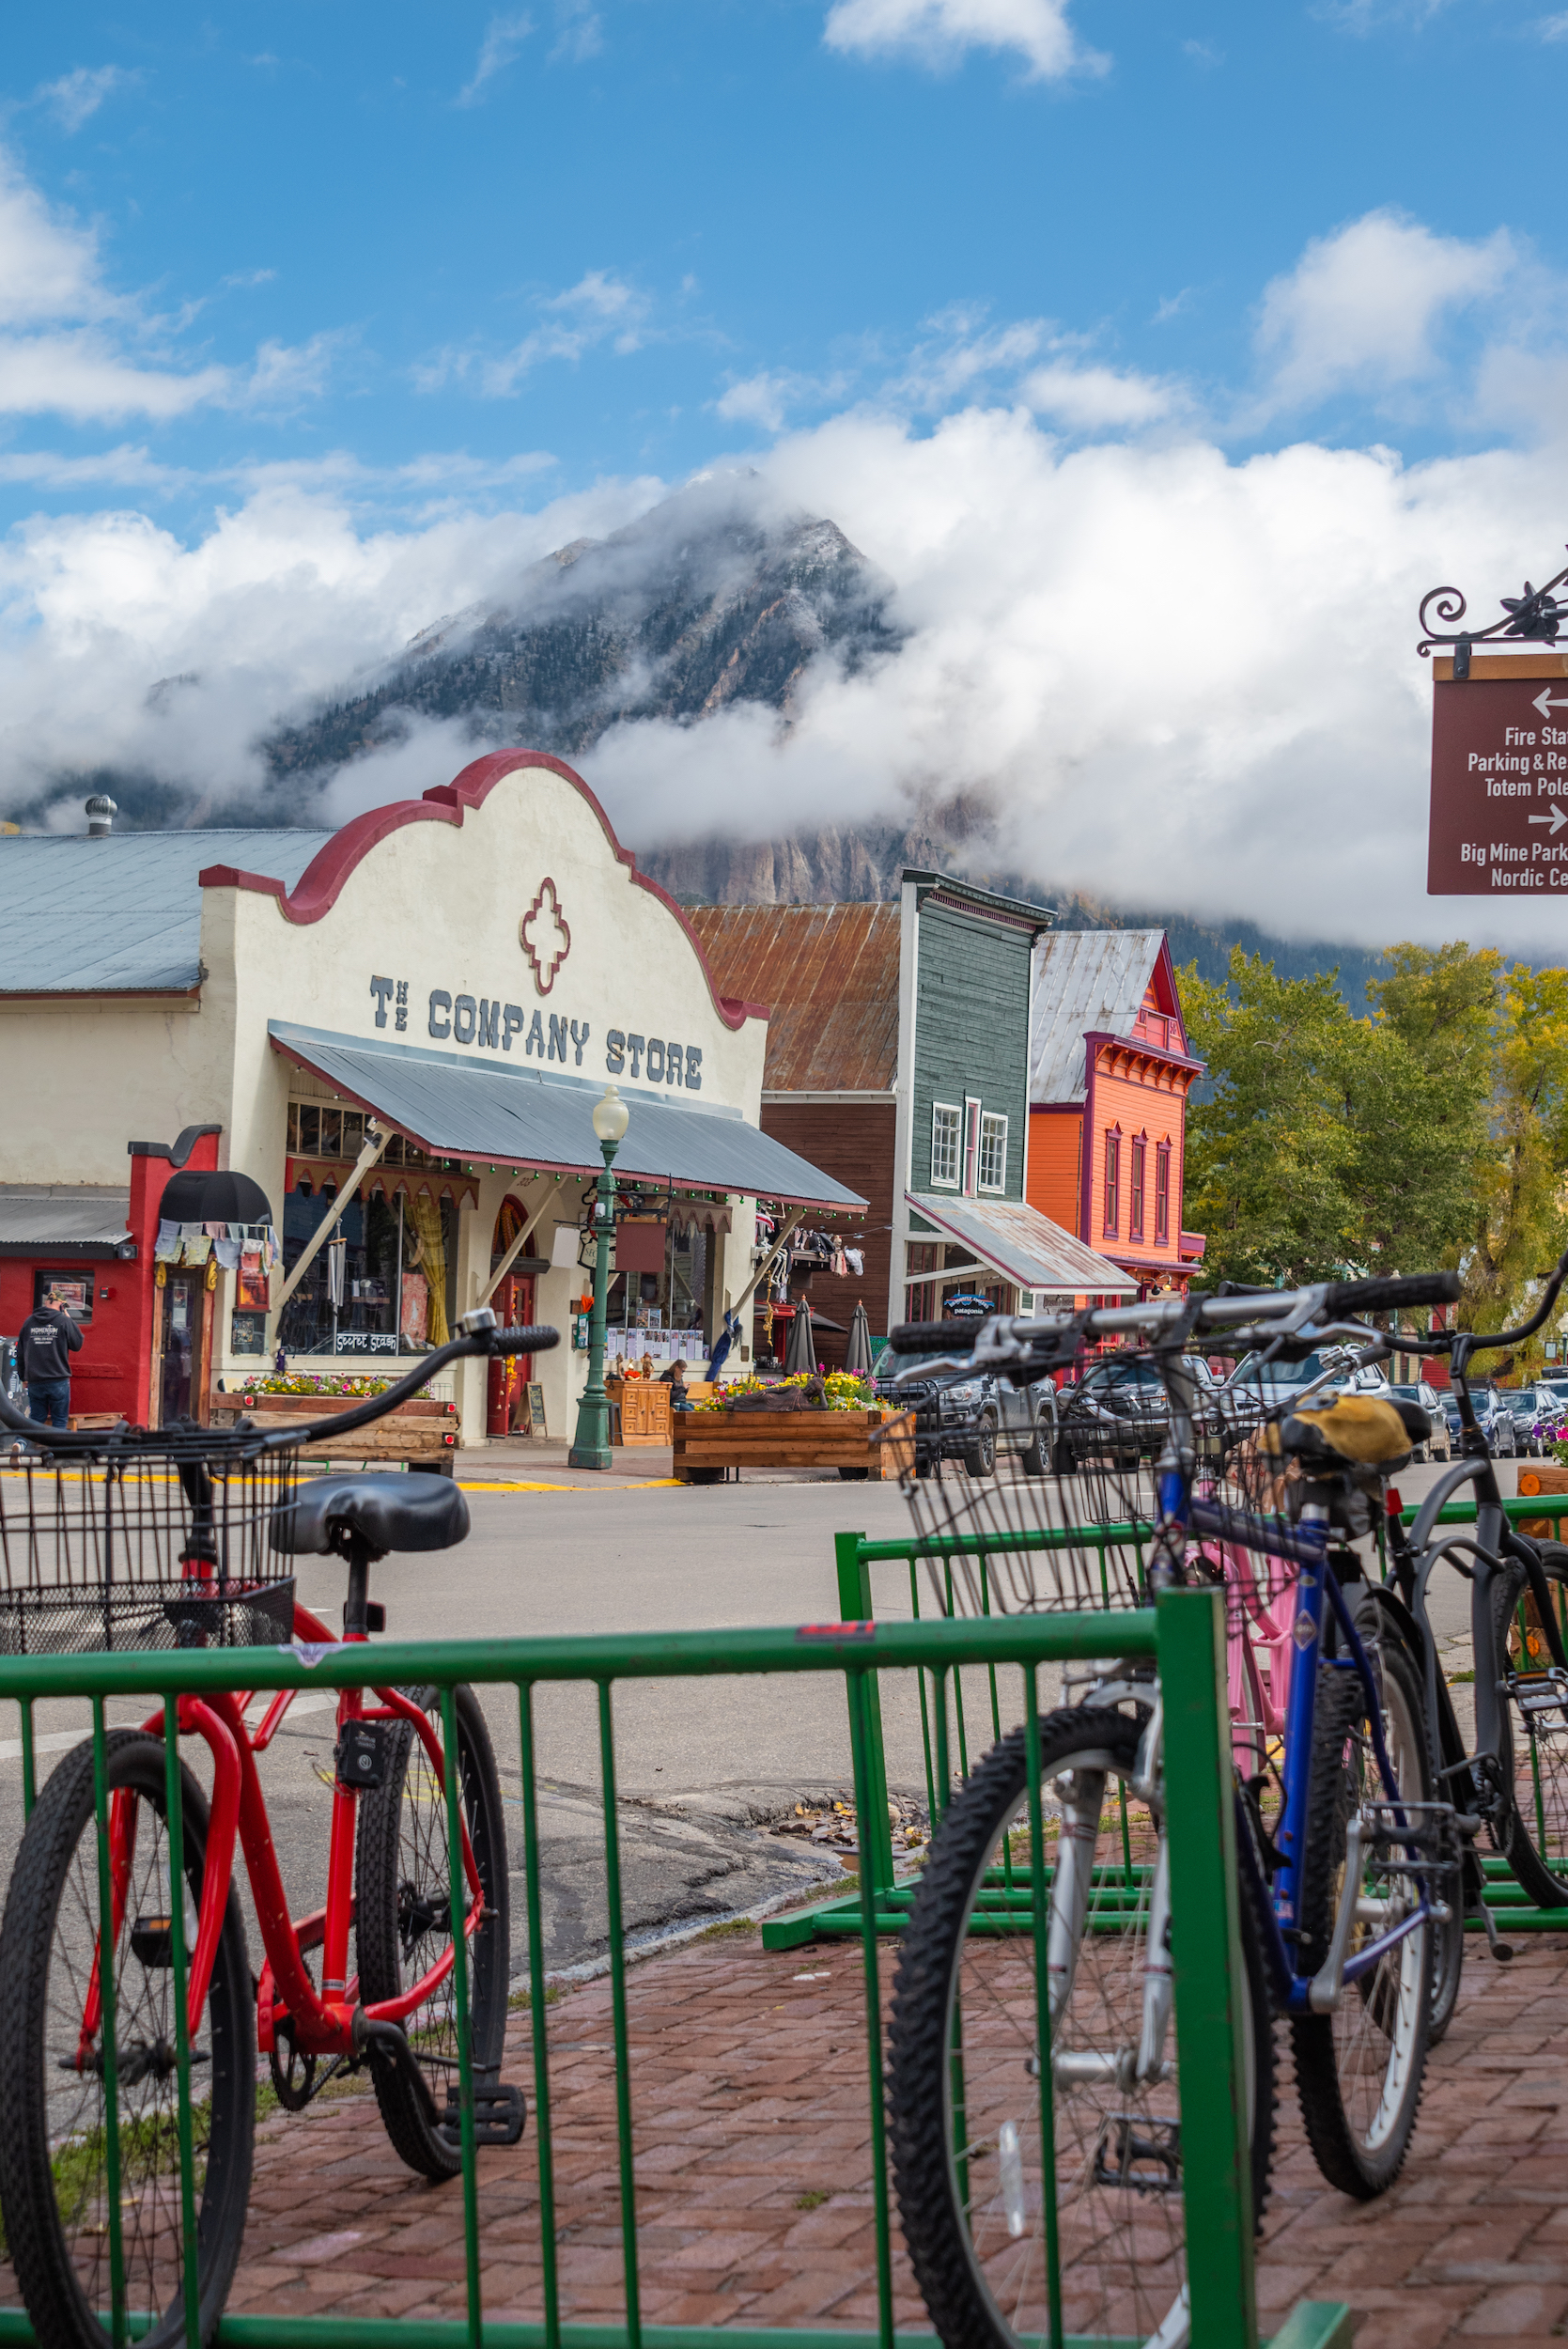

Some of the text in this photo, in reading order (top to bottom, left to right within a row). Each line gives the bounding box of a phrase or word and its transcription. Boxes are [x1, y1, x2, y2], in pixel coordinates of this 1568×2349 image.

[1505, 726, 1568, 746] Fire Sta
[1468, 752, 1568, 776] Parking & Re
[1485, 778, 1531, 797] Totem
[1461, 843, 1568, 866] Big Mine Park
[1492, 868, 1545, 887] Nordic
[427, 988, 590, 1066] COMPANY
[606, 1028, 703, 1090] STORE
